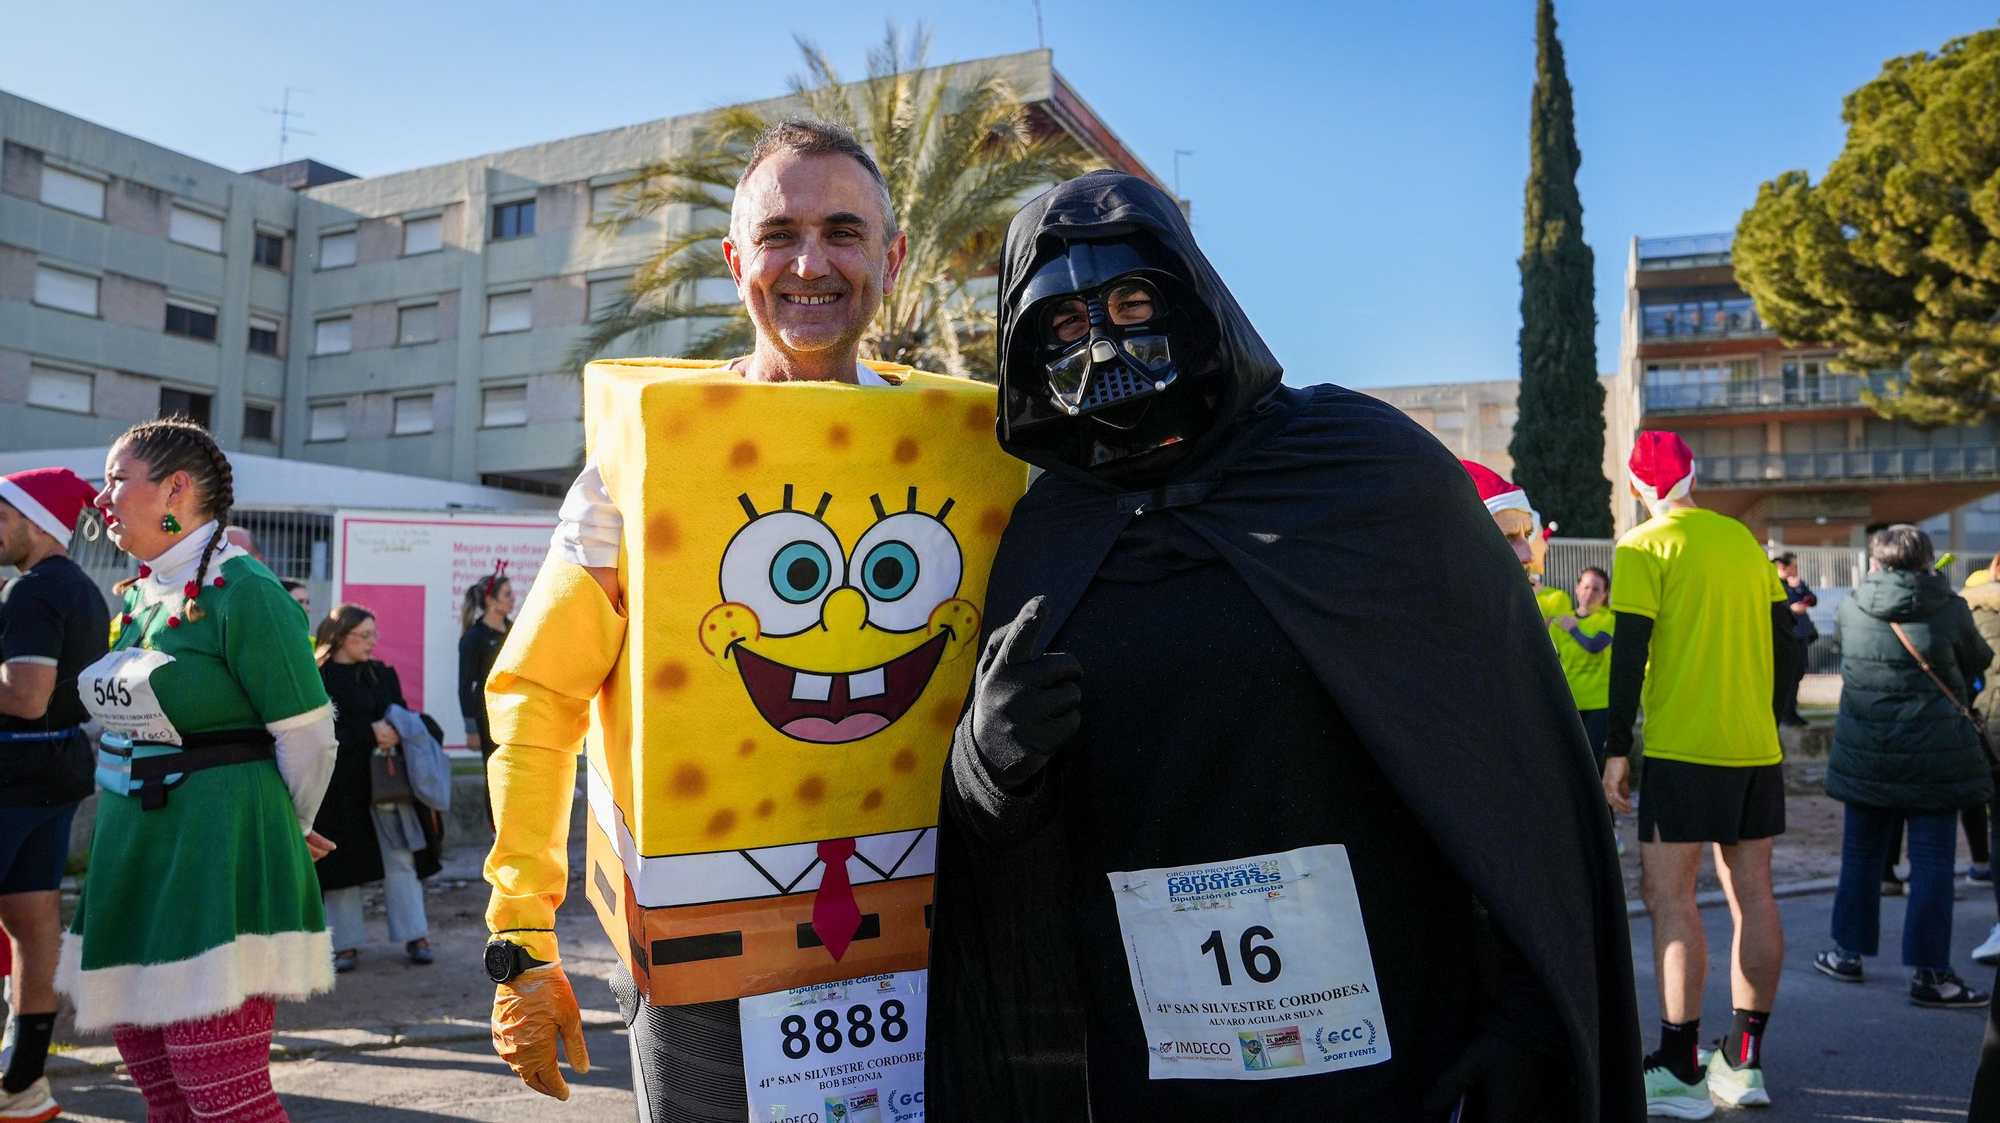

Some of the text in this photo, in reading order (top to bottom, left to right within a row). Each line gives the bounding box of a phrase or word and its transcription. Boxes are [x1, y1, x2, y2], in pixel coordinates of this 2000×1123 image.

[453, 543, 492, 555] Mejora
[495, 543, 509, 553] de
[453, 558, 540, 572] en los Cegios
[94, 677, 132, 707] 545
[1166, 859, 1279, 878] CIRCUITO PROVINCIAL 20
[1167, 867, 1261, 887] carreras
[1168, 872, 1282, 896] populares
[1170, 892, 1222, 904] Diputación
[1224, 889, 1237, 898] de
[1239, 884, 1284, 896] Córdoba
[1200, 925, 1282, 986] 16
[788, 972, 895, 995] Diputación de Córdoba
[1175, 1003, 1200, 1014] SAN
[1202, 999, 1277, 1014] SILVESTRE
[1279, 982, 1371, 1009] CORDOBESA
[1209, 1009, 1324, 1026] ALVARO AGUILAR SILVA
[780, 998, 909, 1060] 8888
[1275, 1034, 1300, 1043] PARQUE
[1328, 1026, 1363, 1044] GCC
[1175, 1041, 1231, 1055] IMDECO
[1324, 1046, 1377, 1063] SPORT EVENTS
[778, 1073, 801, 1085] SAN
[804, 1060, 865, 1081] SILVESTRE
[867, 1051, 926, 1069] CORDOBE
[819, 1072, 883, 1090] BOB ESPONJA
[895, 1112, 918, 1123] SPORT
